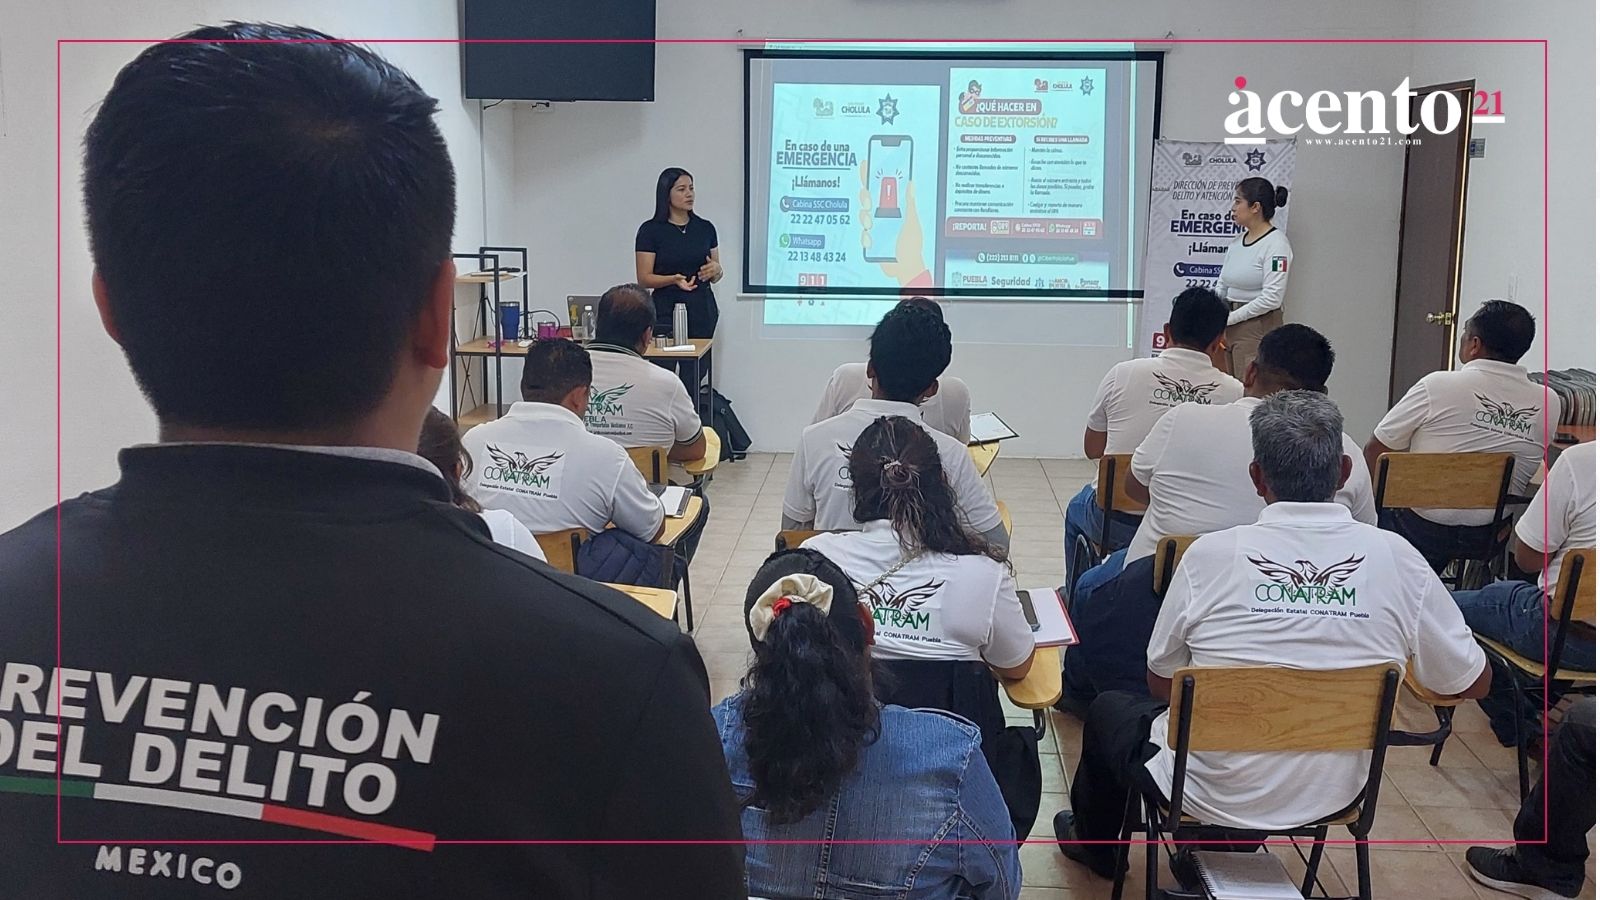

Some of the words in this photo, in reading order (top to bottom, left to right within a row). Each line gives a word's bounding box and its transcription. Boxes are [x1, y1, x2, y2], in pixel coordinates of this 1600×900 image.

[841, 106, 871, 114] CHOLULA
[976, 100, 996, 113] ¿QUÉ
[998, 102, 1024, 112] HACER
[1026, 102, 1037, 112] EN
[955, 116, 982, 128] CASO
[984, 116, 996, 128] DE
[997, 114, 1058, 128] EXTORSIÓN?
[785, 139, 797, 151] En
[799, 142, 819, 151] caso
[820, 140, 832, 152] de
[833, 142, 850, 152] una
[776, 151, 858, 167] EMERGENCIA
[792, 175, 841, 191] ¡Llámanos!
[1173, 179, 1206, 190] DIRECCIÓN
[1207, 181, 1217, 190] DE
[1172, 191, 1195, 200] DELITO
[1195, 191, 1201, 200] Y
[1201, 190, 1233, 201] ATENCIÓN
[792, 199, 812, 209] Cabina
[812, 199, 825, 209] SSC
[825, 199, 848, 209] Cholula
[790, 213, 801, 224] 22
[802, 214, 813, 225] 22
[814, 214, 824, 225] 47
[826, 214, 837, 225] 05
[839, 214, 850, 225] 62
[1181, 209, 1195, 220] En
[1198, 211, 1222, 221] caso
[952, 222, 987, 231] ¡REPORTA!
[1170, 220, 1246, 235] EMERGEN
[792, 236, 822, 247] Whatsapp
[788, 251, 798, 262] 22
[800, 251, 809, 262] 13
[810, 251, 821, 262] 48
[823, 251, 834, 262] 43
[835, 252, 846, 263] 24
[1189, 265, 1213, 274] Cabina
[1213, 266, 1221, 275] SS
[799, 274, 825, 286] 911
[991, 276, 1031, 288] Seguridad
[1185, 278, 1197, 288] 22
[1200, 279, 1211, 289] 22
[583, 415, 607, 424] EBLA
[1475, 410, 1532, 435] CONATRAM
[484, 466, 550, 490] CONATRAM
[515, 487, 542, 497] CONATRAM
[1255, 583, 1356, 606] CONATRAM
[1251, 606, 1284, 614] Delegación
[1310, 609, 1347, 617] CONATRAM
[873, 607, 930, 632] ATRAM
[883, 631, 920, 642] CONATRAM
[0, 661, 440, 764] REVENCIÓN
[128, 732, 398, 816] DELITO
[94, 844, 242, 890] MEXICO
